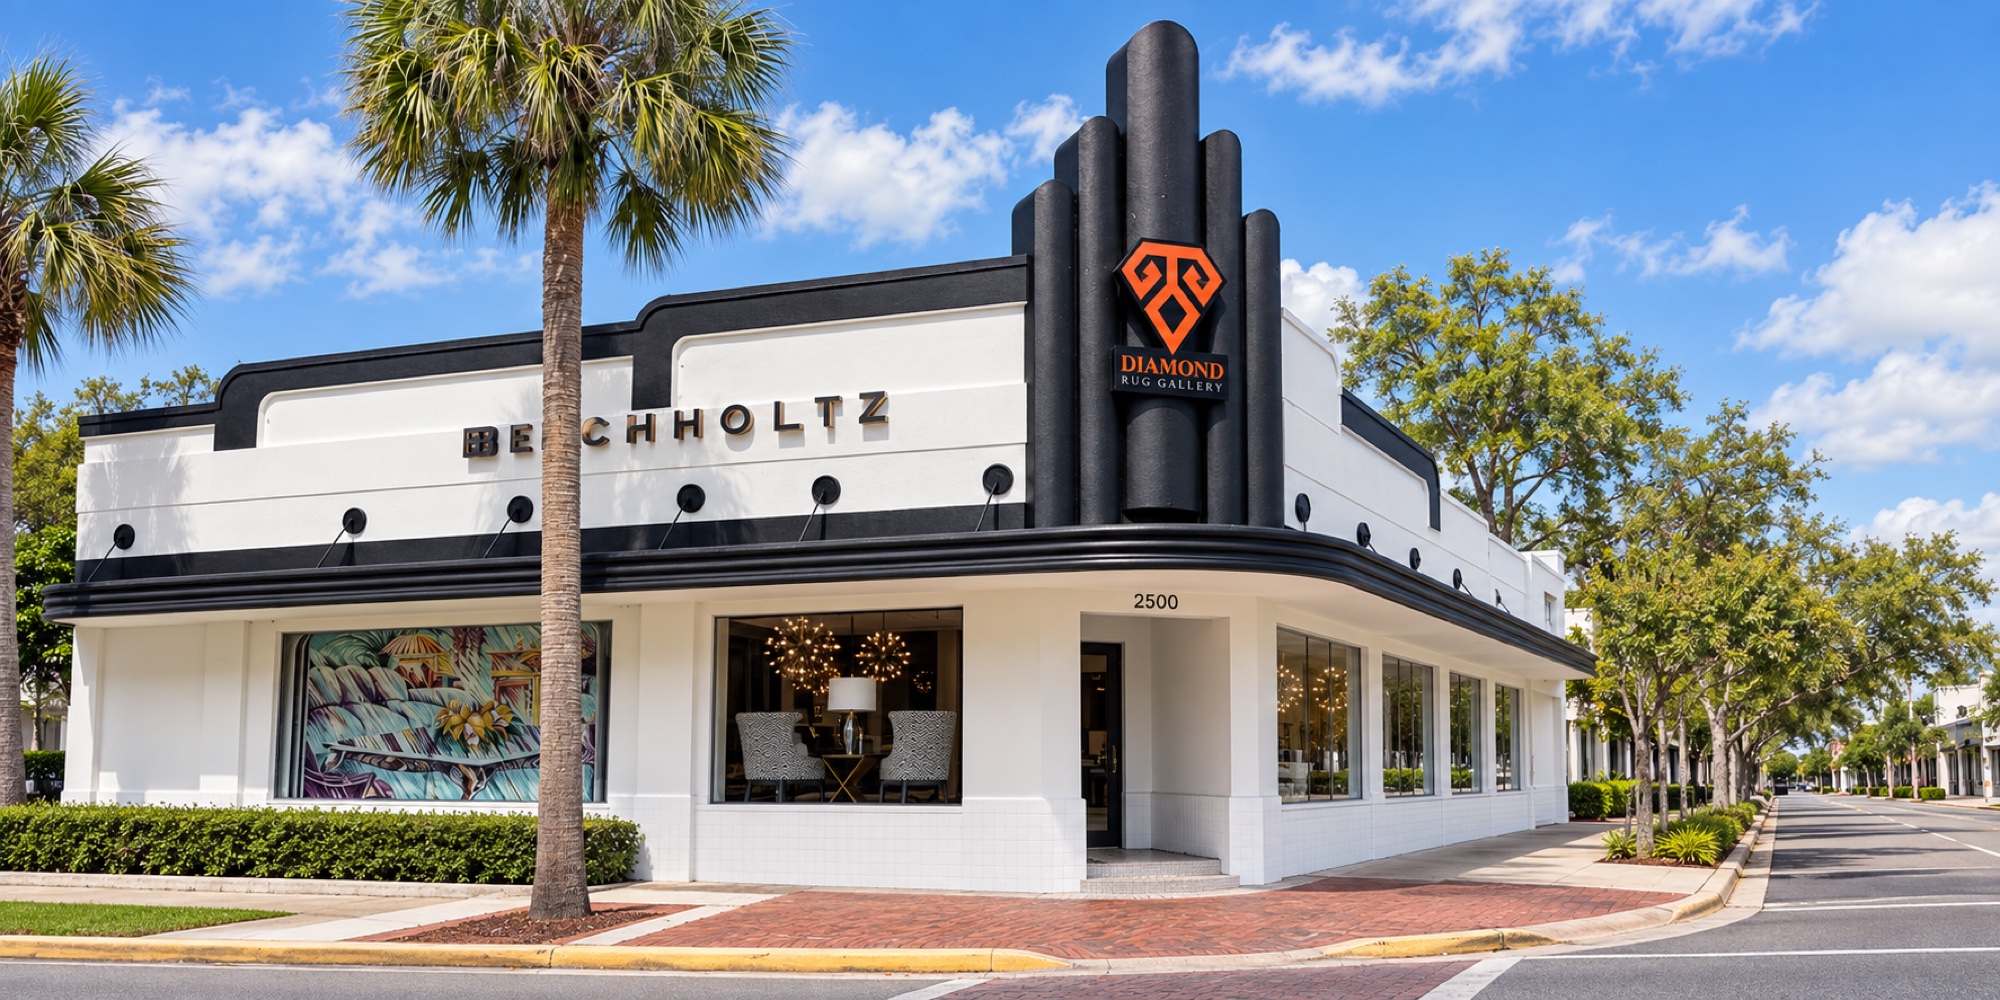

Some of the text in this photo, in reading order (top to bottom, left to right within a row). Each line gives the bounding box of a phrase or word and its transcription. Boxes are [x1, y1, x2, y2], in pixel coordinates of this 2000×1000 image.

[1121, 354, 1225, 380] DIAMOND
[1121, 375, 1223, 393] RUG GALLERY
[463, 391, 888, 458] BECHHOLTZ
[1134, 593, 1179, 610] 2500
